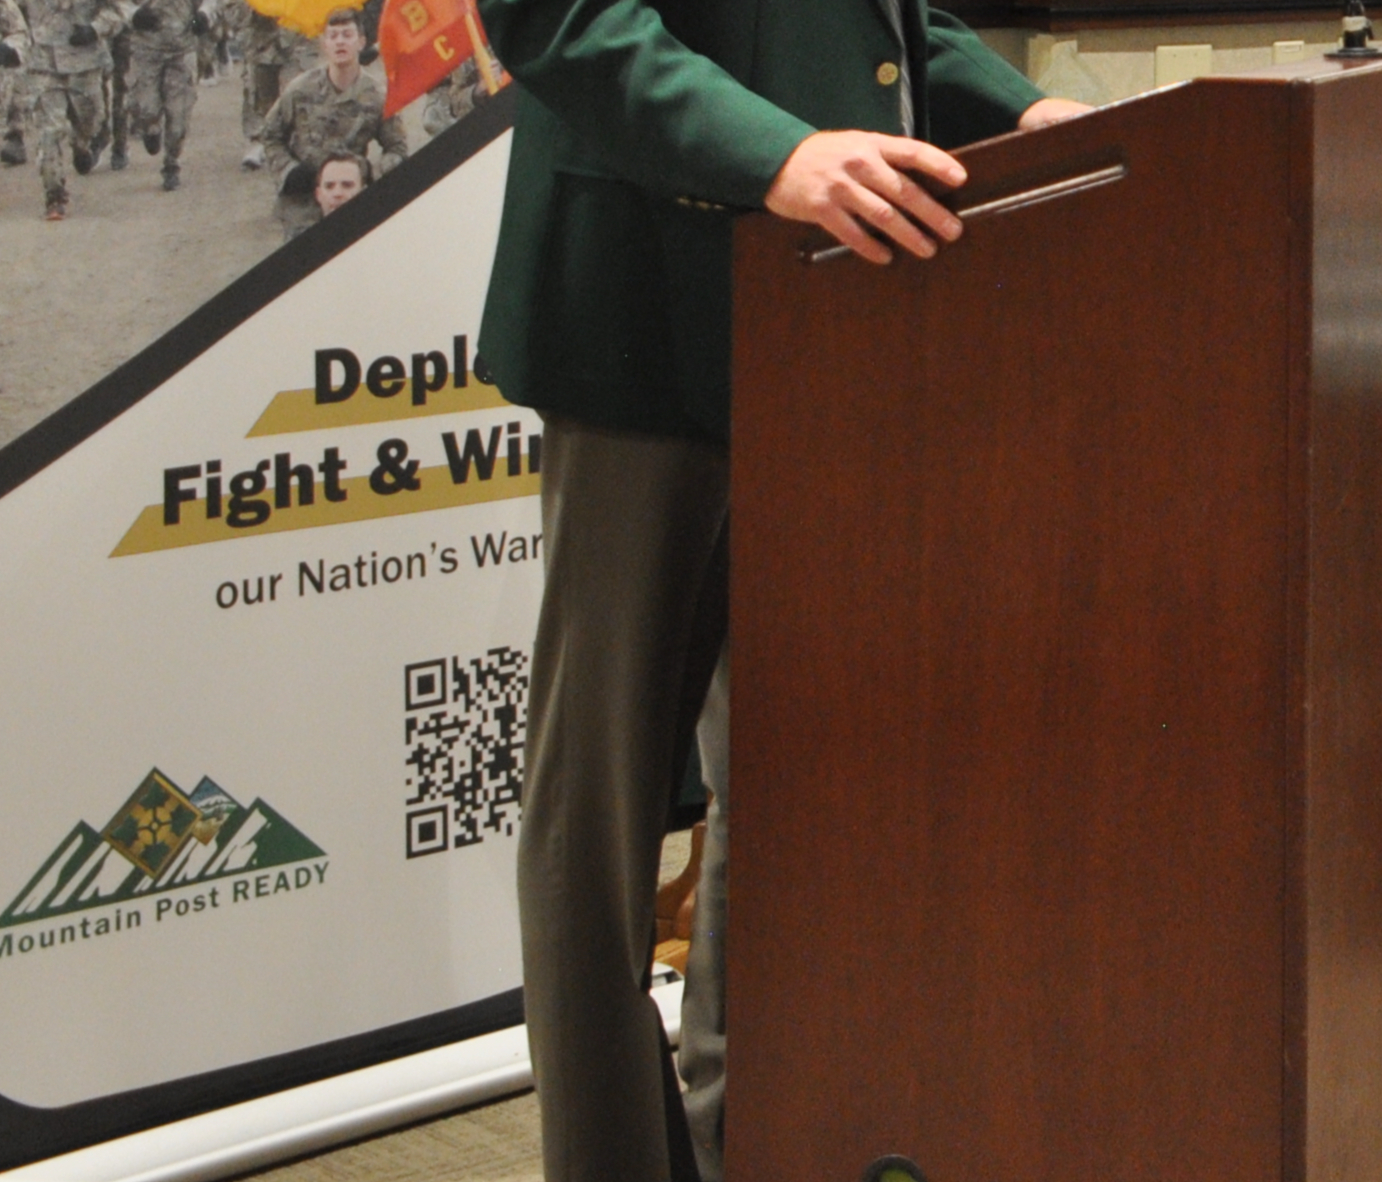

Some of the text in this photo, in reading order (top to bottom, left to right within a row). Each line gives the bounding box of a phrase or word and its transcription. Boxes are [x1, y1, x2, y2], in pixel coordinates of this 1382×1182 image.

[163, 446, 348, 528] Fight
[368, 437, 422, 496] &
[215, 572, 283, 609] our
[155, 886, 221, 921] Post
[232, 861, 330, 903] READY
